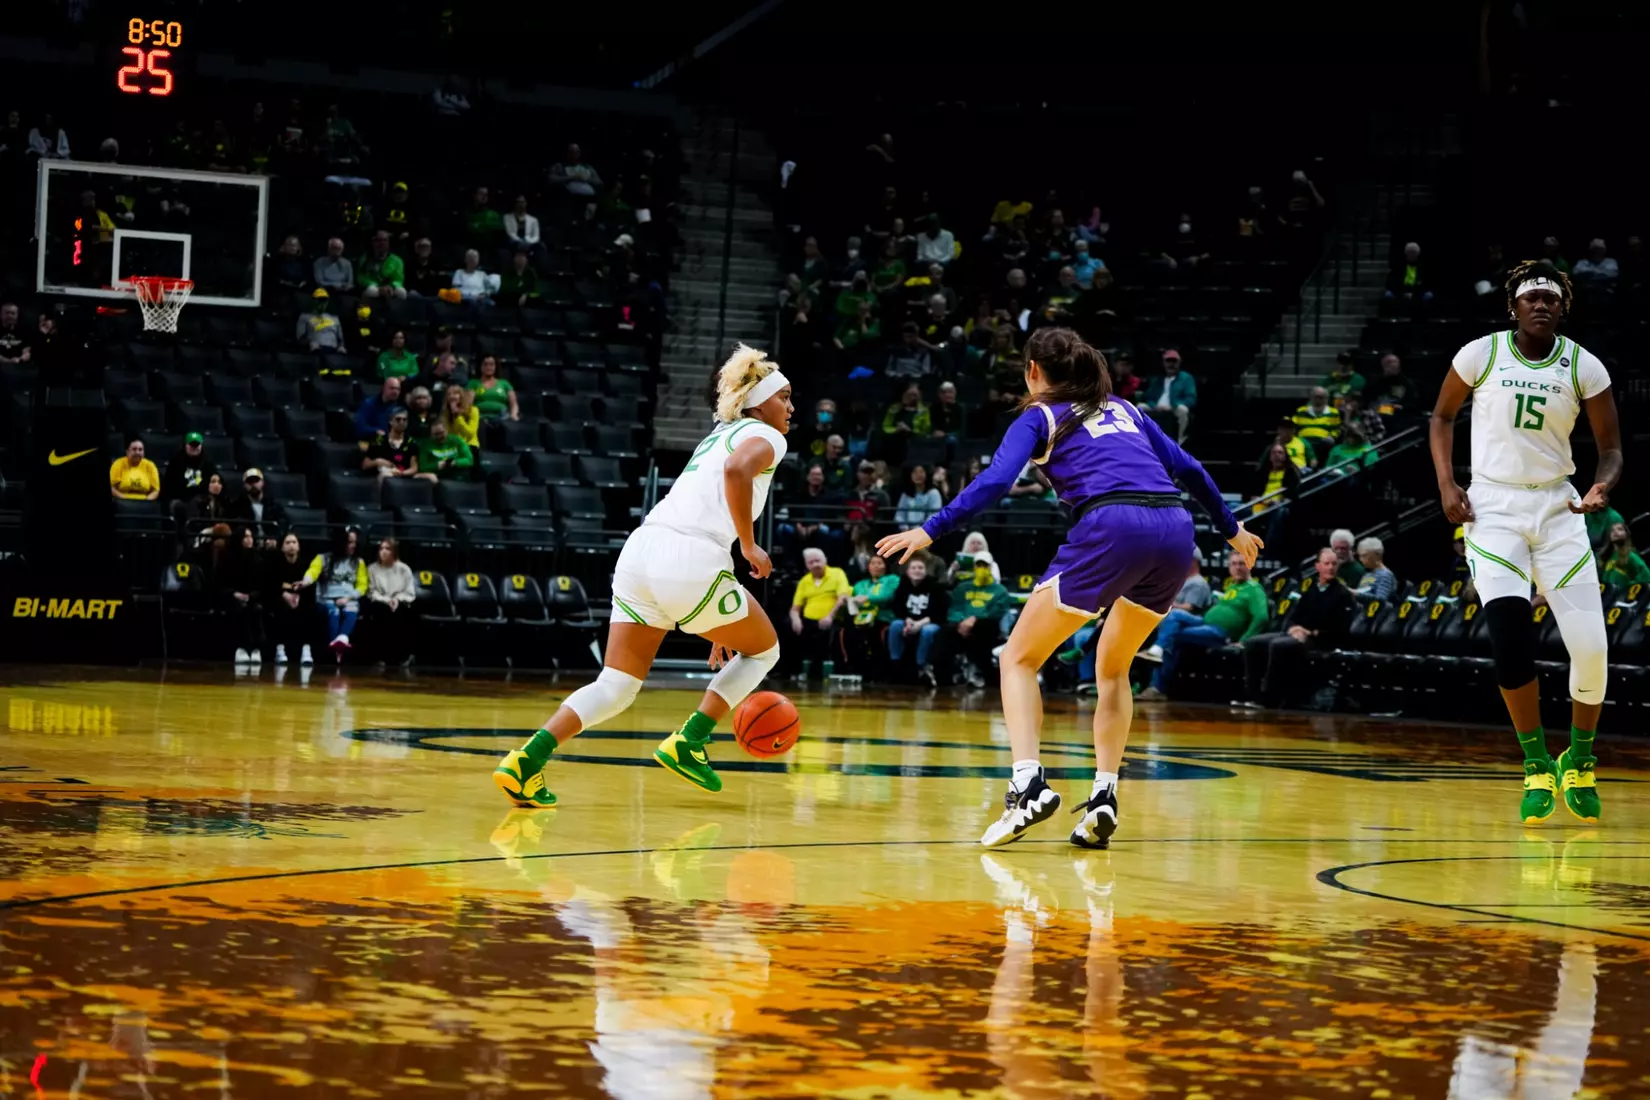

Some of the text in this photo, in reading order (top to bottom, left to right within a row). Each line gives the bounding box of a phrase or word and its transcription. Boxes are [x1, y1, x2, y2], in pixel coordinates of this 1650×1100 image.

[128, 17, 182, 47] 8:50
[118, 47, 172, 95] 25
[1501, 379, 1562, 394] DUCKS
[1070, 401, 1140, 439] 23
[1513, 393, 1547, 431] 15
